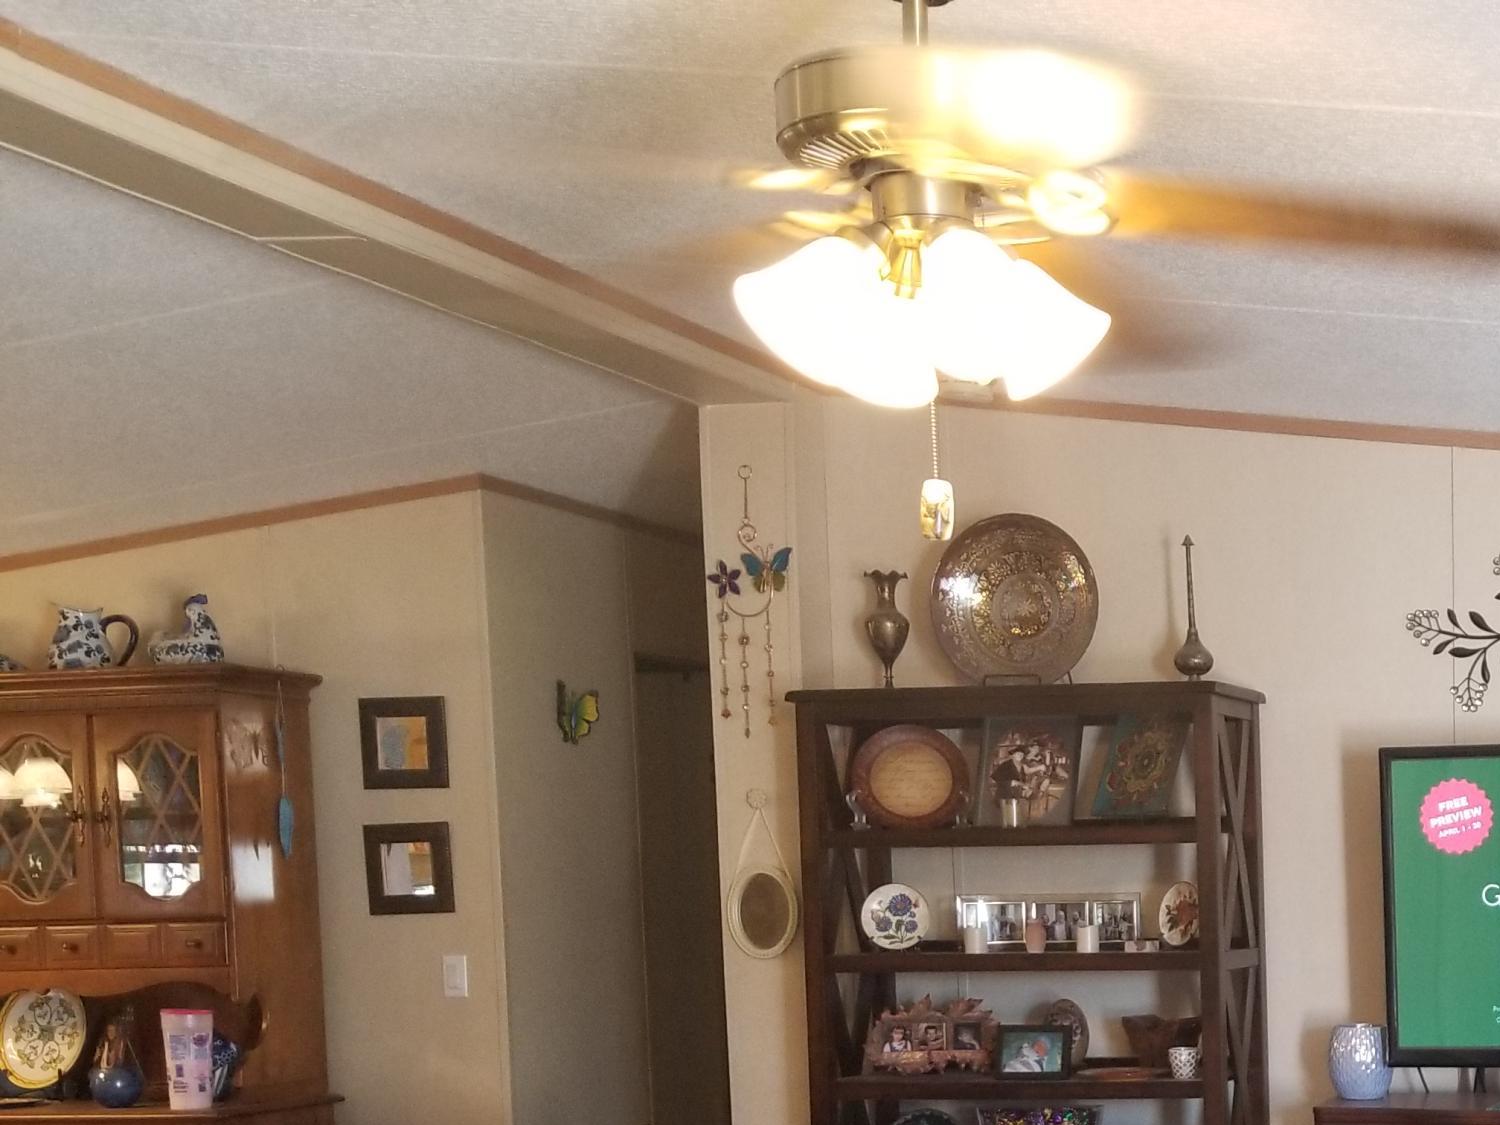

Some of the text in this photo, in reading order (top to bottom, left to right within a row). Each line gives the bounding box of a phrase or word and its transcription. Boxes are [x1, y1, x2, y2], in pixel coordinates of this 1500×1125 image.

[1438, 796, 1469, 812] FREE
[1430, 806, 1482, 828] PREVIEW
[1439, 827, 1460, 838] APRIL
